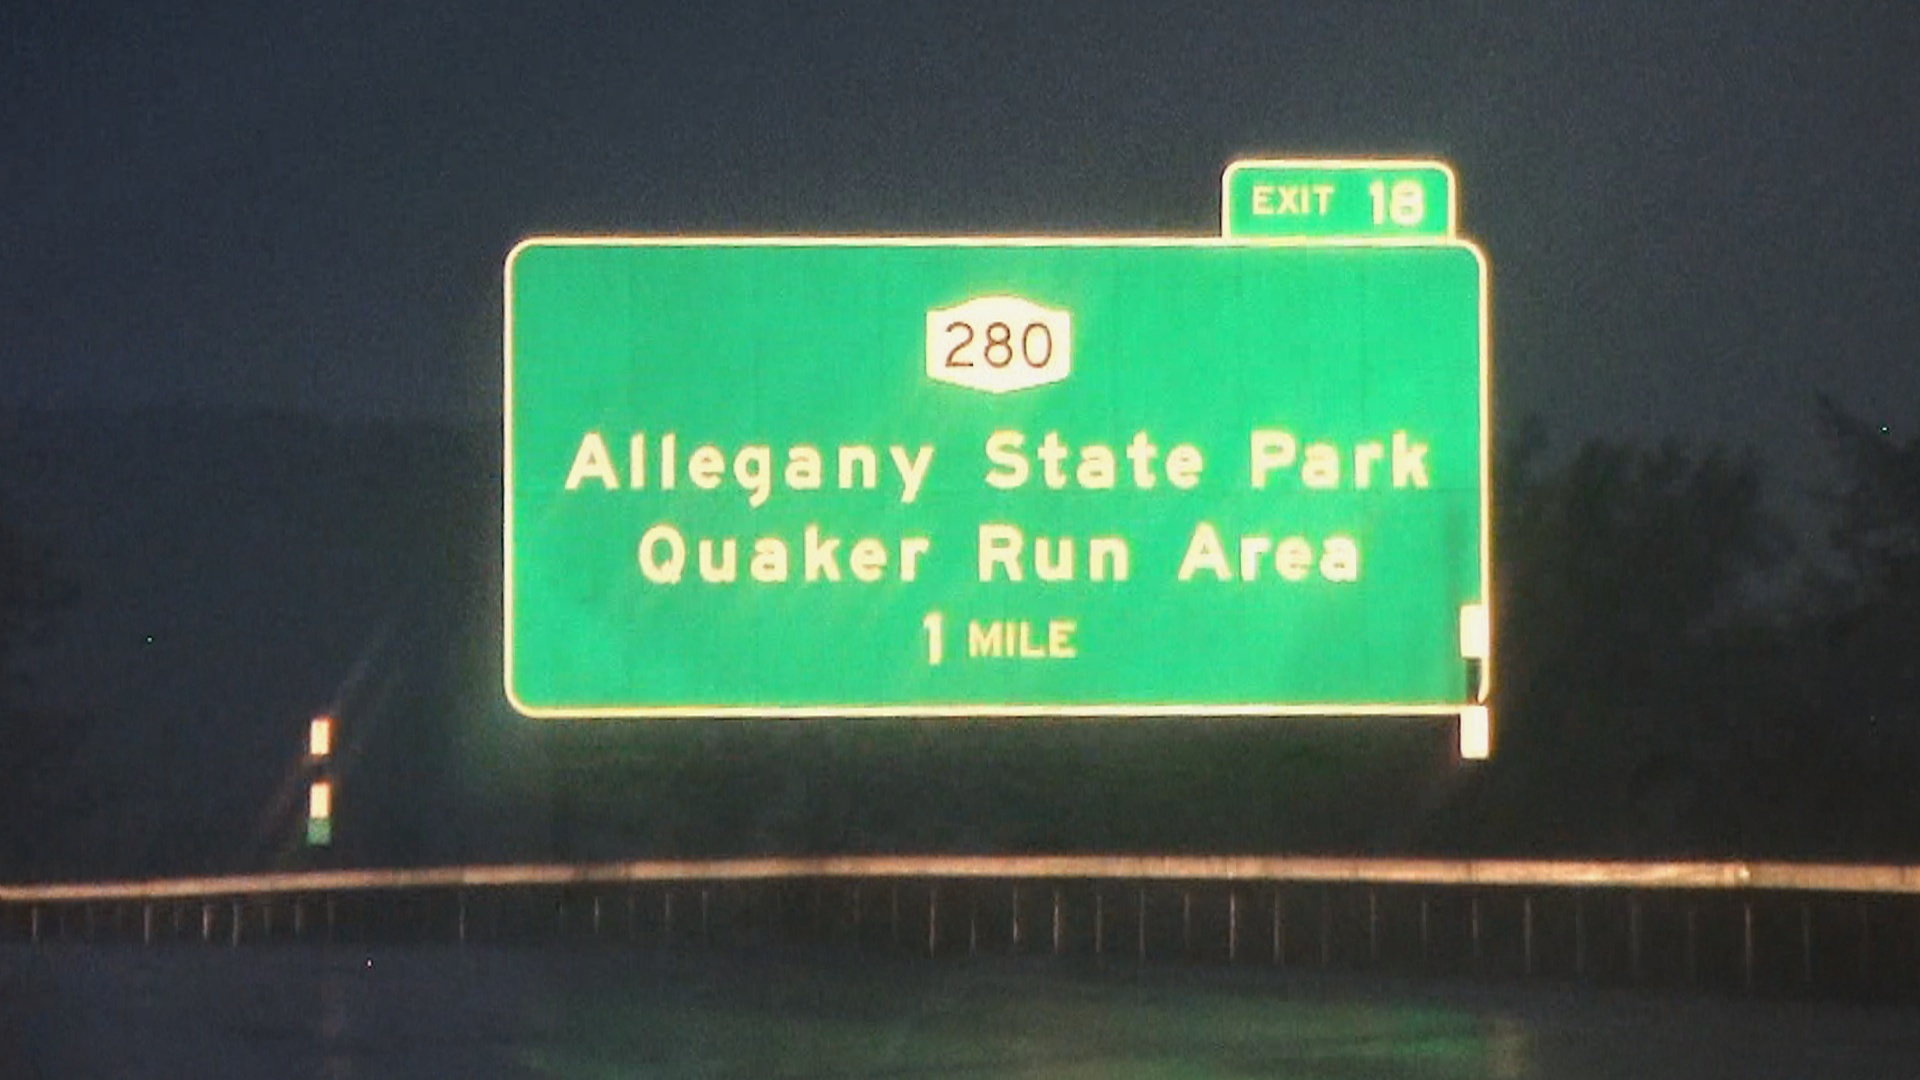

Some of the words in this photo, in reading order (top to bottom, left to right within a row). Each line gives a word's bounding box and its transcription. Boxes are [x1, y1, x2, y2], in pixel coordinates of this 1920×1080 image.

[1252, 184, 1334, 216] EXIT
[1369, 179, 1425, 228] 18
[945, 321, 1052, 369] 280
[565, 431, 934, 504] Allegany
[986, 429, 1204, 490] State
[1251, 429, 1430, 489] Park
[638, 523, 930, 585] Quaker
[978, 522, 1130, 583] Run
[1178, 522, 1361, 583] Area
[923, 611, 945, 665] 1
[968, 620, 1076, 659] MILE
